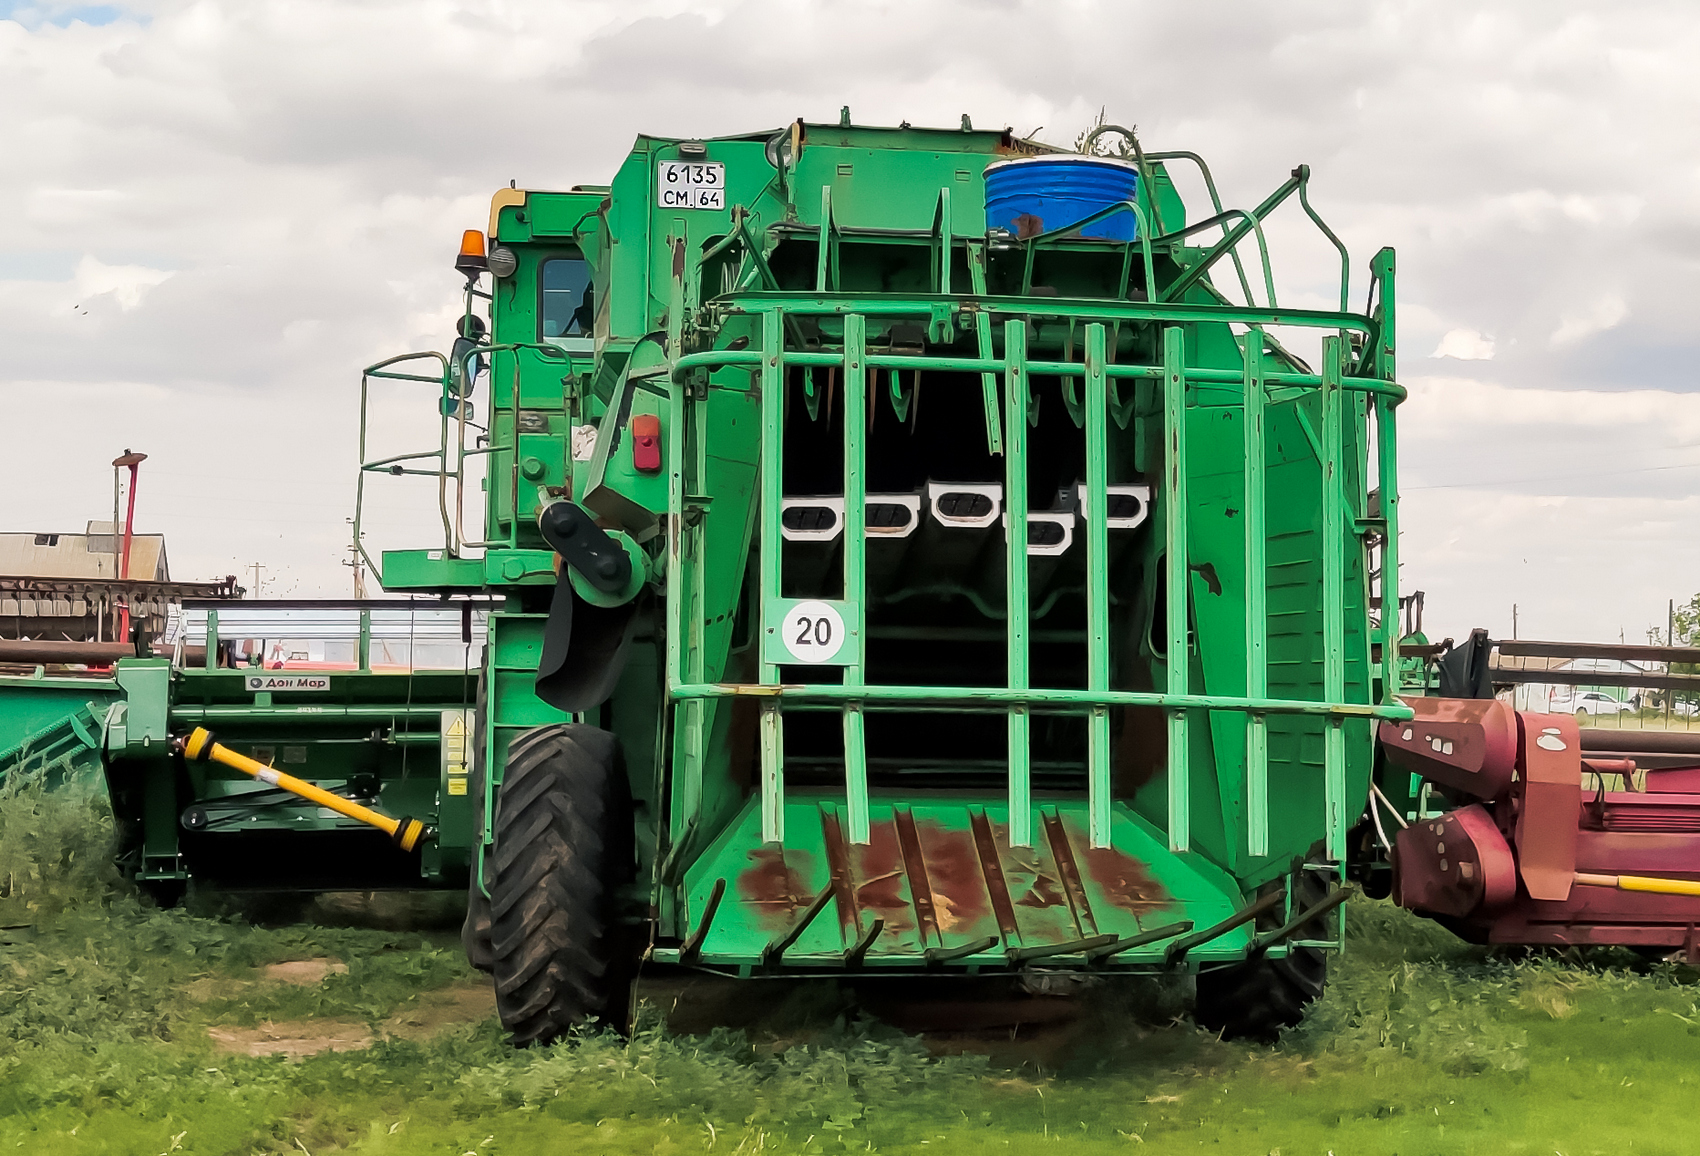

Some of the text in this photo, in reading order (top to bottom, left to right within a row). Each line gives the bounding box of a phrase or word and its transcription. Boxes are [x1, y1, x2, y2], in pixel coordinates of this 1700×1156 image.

[666, 165, 717, 185] 6135
[699, 191, 719, 207] 64
[796, 616, 832, 646] 20
